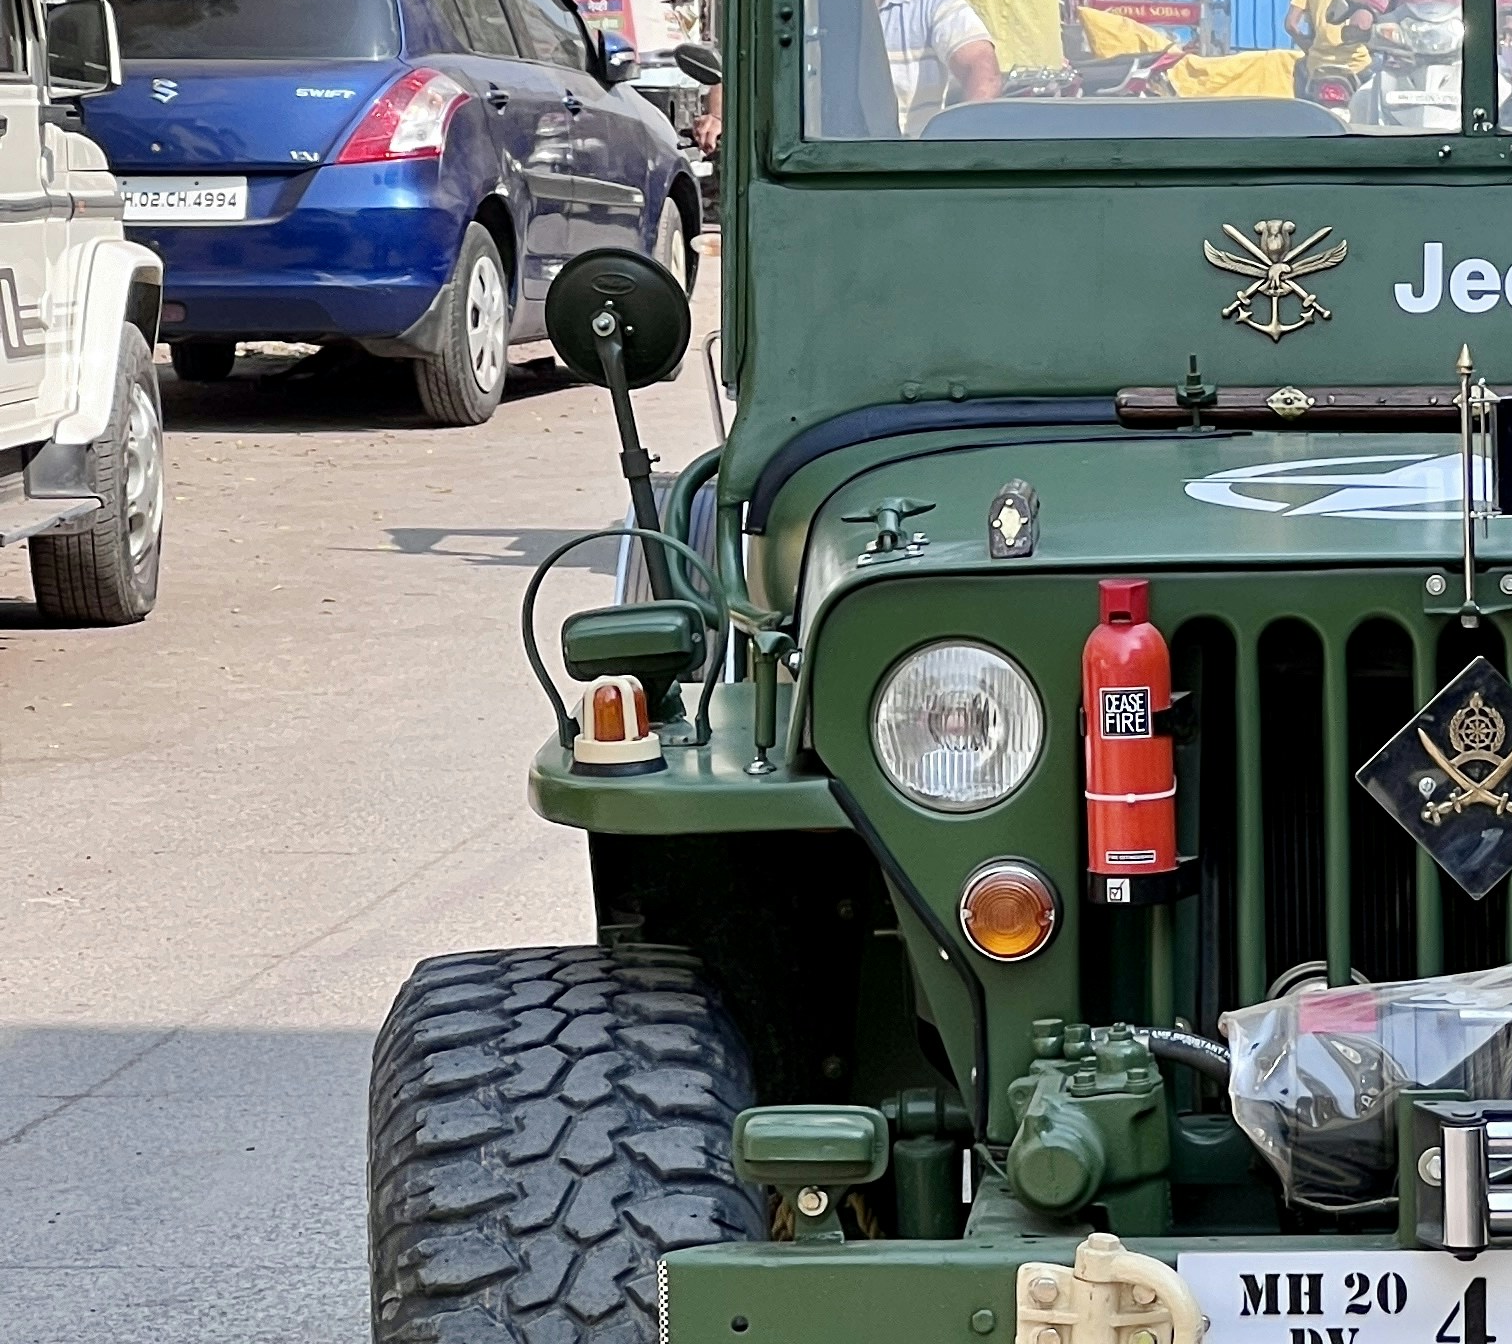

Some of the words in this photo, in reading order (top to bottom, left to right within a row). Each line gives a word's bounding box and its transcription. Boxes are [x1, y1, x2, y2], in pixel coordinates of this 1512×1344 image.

[1150, 6, 1180, 18] SODA
[296, 88, 356, 99] SWIFT
[123, 191, 237, 208] H.02.CH.4994
[1105, 692, 1146, 713] CEASE
[1105, 712, 1146, 733] FIRE
[1239, 1272, 1325, 1316] MH
[1344, 1271, 1408, 1316] 20
